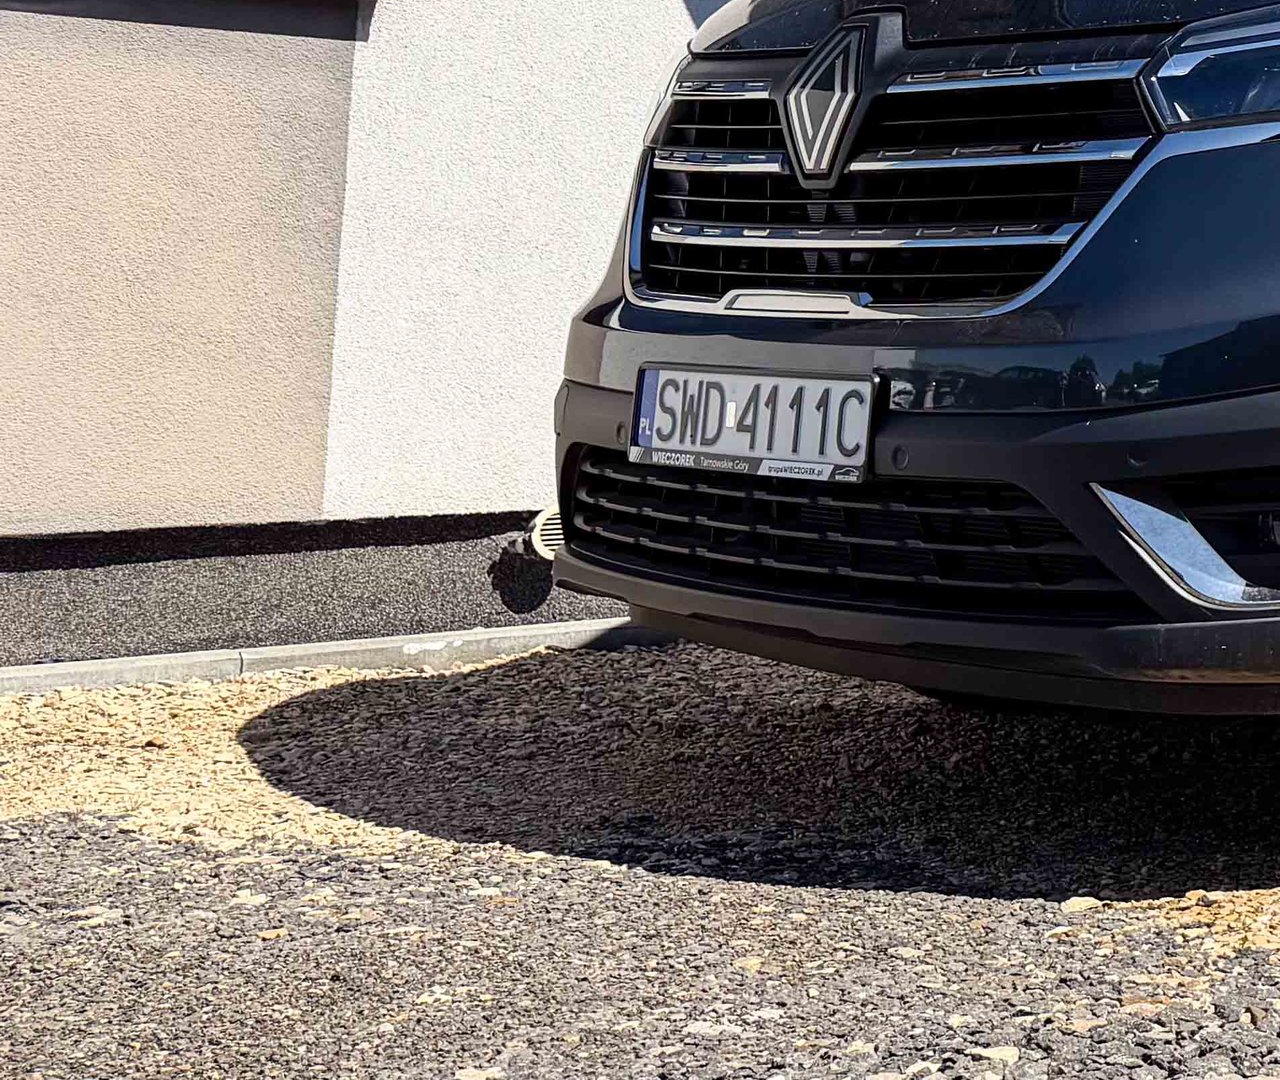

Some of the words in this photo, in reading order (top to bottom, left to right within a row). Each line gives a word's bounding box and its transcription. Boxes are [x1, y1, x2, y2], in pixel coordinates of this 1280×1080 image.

[639, 417, 651, 436] PL
[655, 378, 726, 446] SWD
[736, 383, 865, 457] 4111C
[652, 451, 695, 466] WIECZOREK
